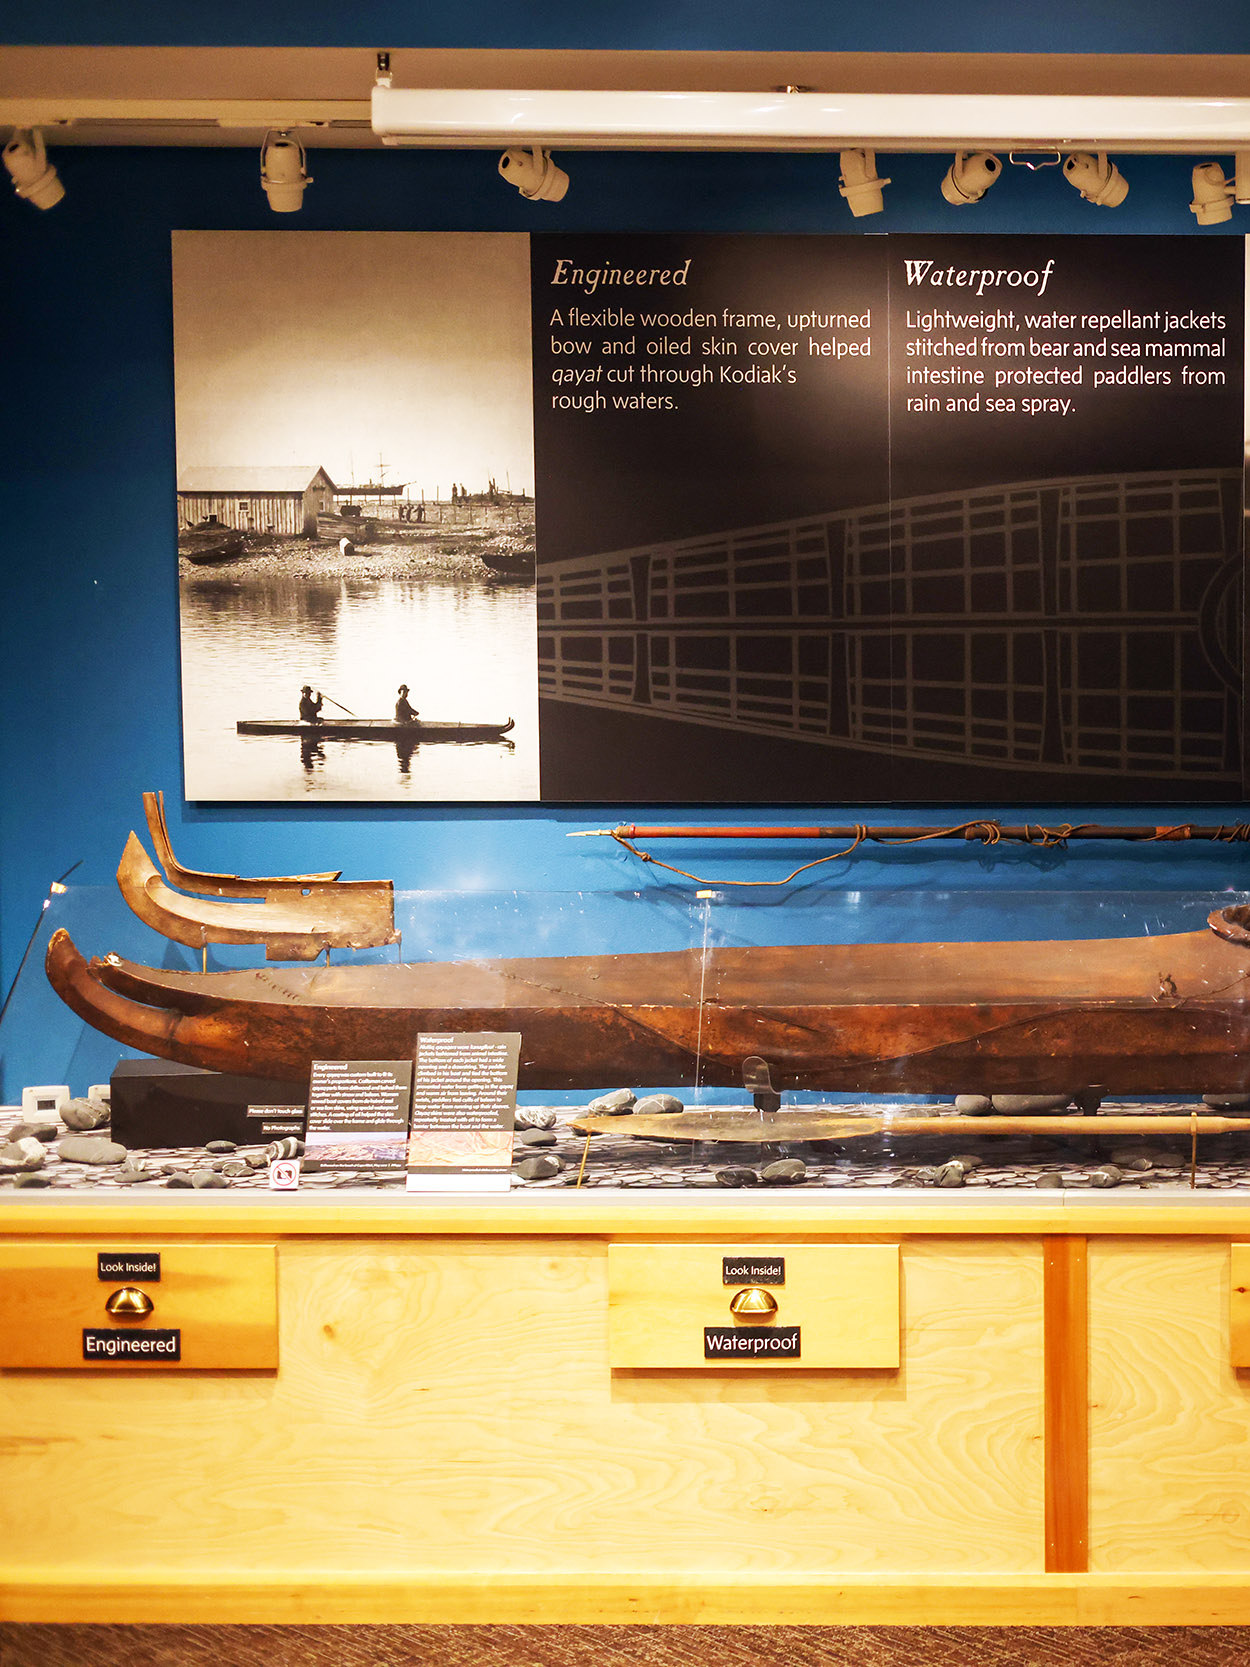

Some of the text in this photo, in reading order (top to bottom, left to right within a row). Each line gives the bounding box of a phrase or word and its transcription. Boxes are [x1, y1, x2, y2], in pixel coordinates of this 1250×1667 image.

[550, 258, 692, 293] Engineered
[903, 259, 1055, 297] Waterproof
[549, 307, 871, 332] A flexible wooden frame, upturned
[906, 308, 1226, 333] Lightweight, water repellant jackets
[551, 335, 874, 360] bow and oiled skin cover helped
[905, 336, 1225, 357] stitched from bear and sea mammal
[552, 363, 797, 387] qayat cut through Kodiak's
[906, 364, 1226, 389] intestine protected paddlers from
[552, 390, 679, 413] rough waters.
[907, 392, 1076, 416] rain and sea spray.
[100, 1262, 156, 1272] Look Inside!
[725, 1264, 781, 1275] Look Inside!
[86, 1336, 176, 1356] Engineered
[706, 1332, 798, 1354] Waterproof
